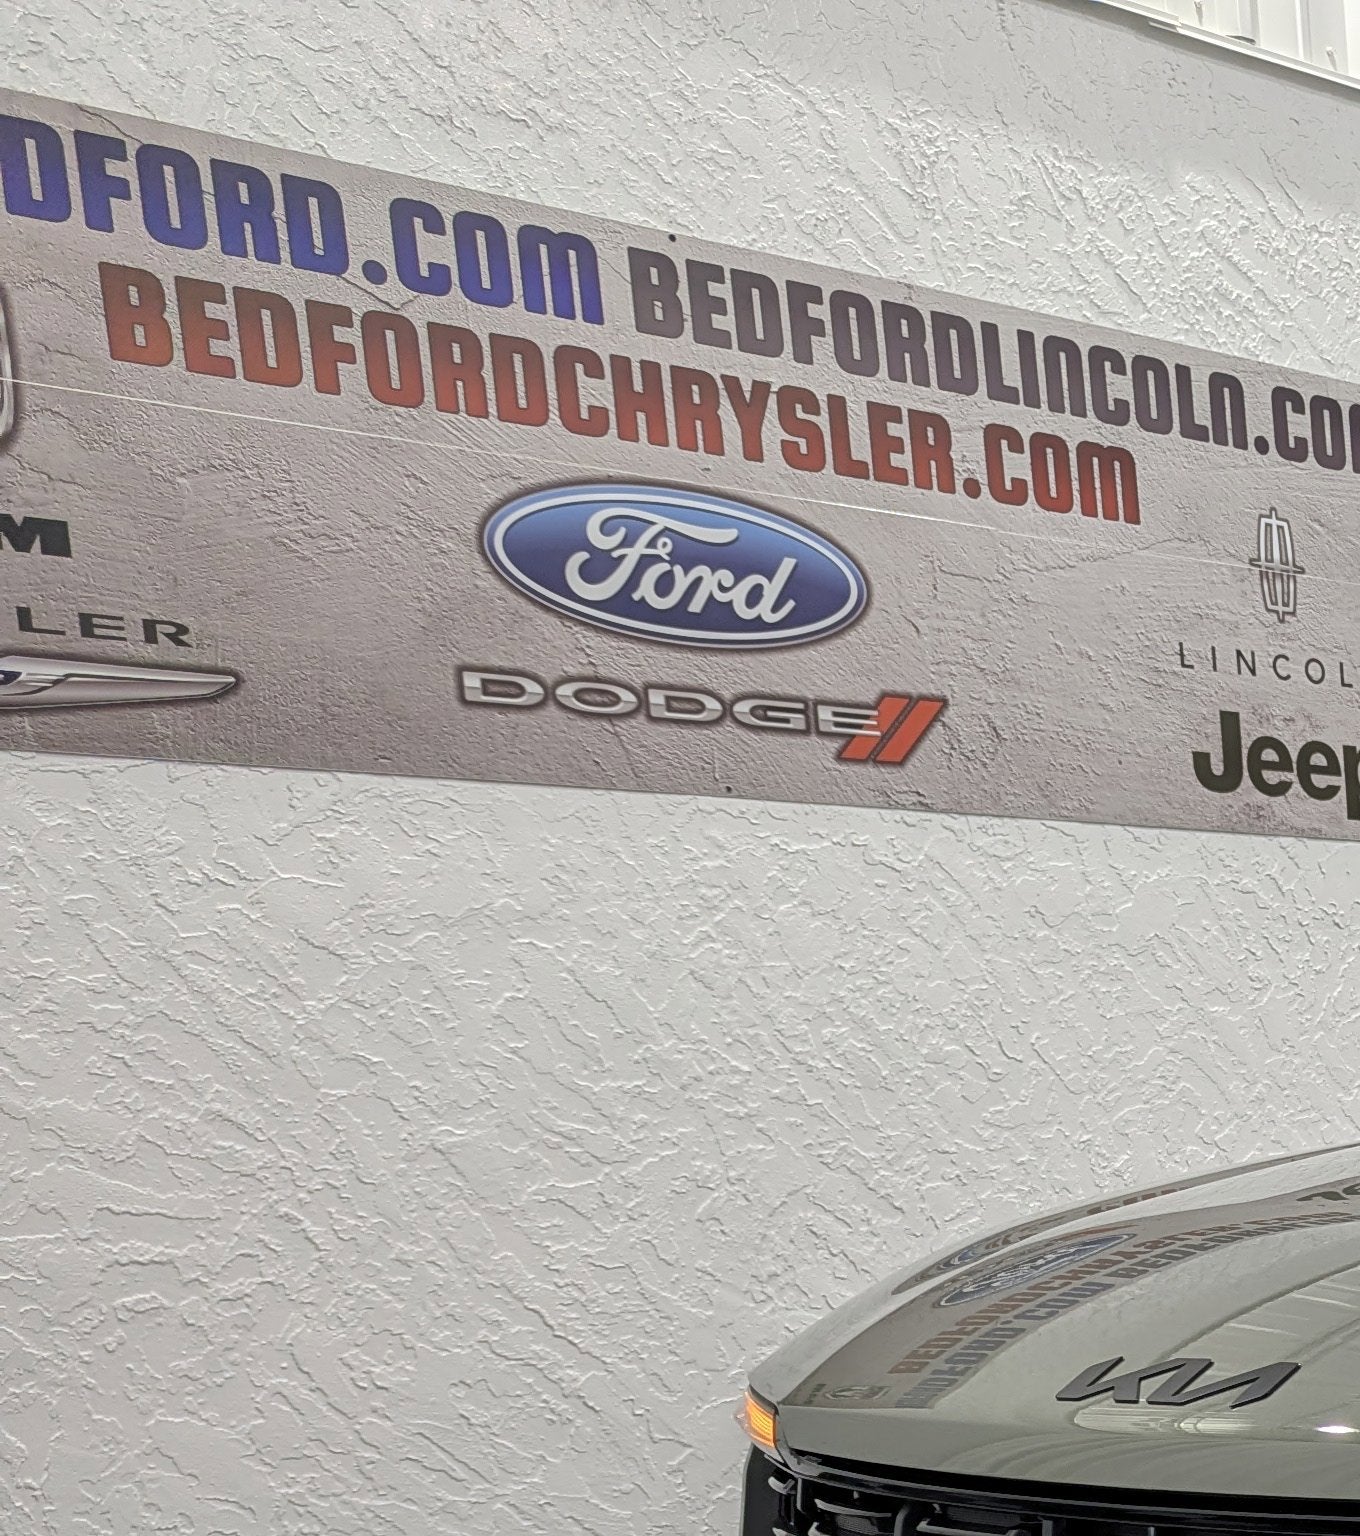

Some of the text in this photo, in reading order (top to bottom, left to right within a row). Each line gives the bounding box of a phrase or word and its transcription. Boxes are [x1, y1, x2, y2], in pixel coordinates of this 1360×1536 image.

[99, 261, 1142, 525] BEDFORDCHRYSLER.COM
[564, 507, 798, 624] Ford
[16, 606, 193, 648] LER
[460, 671, 882, 737] DODGE
